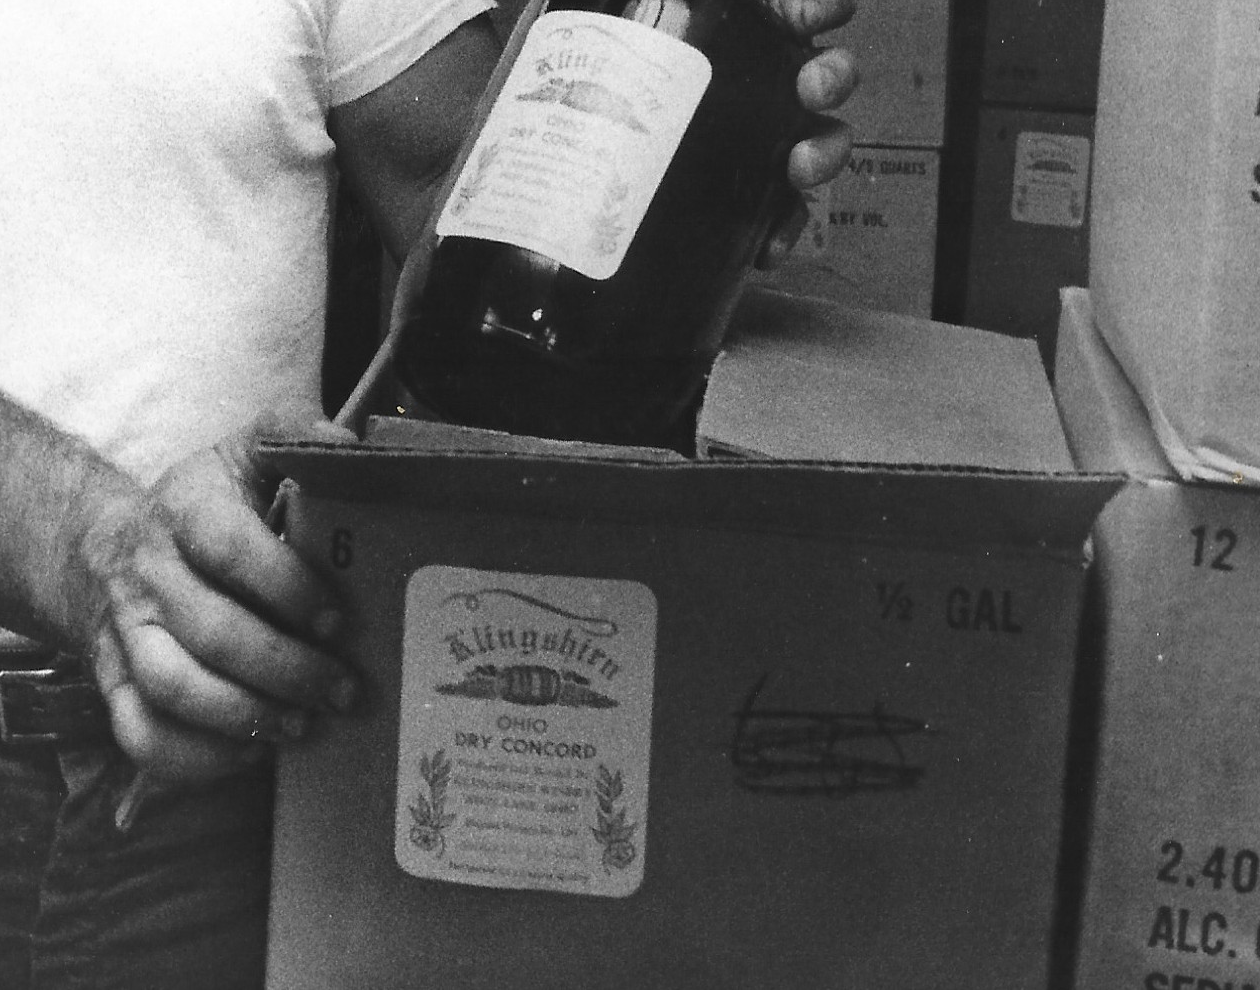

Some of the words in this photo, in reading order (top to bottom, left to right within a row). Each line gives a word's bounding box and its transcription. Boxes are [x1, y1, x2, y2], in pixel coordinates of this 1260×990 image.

[880, 160, 926, 176] QUARTS
[332, 528, 353, 570] 6
[1190, 524, 1237, 572] 12
[946, 586, 1023, 634] GAL
[444, 625, 620, 681] Klingshirn
[455, 731, 492, 750] DRY
[501, 737, 597, 759] CONCORD
[497, 715, 548, 734] OHIO
[1156, 840, 1259, 894] 2.40
[1147, 905, 1237, 959] ALC.
